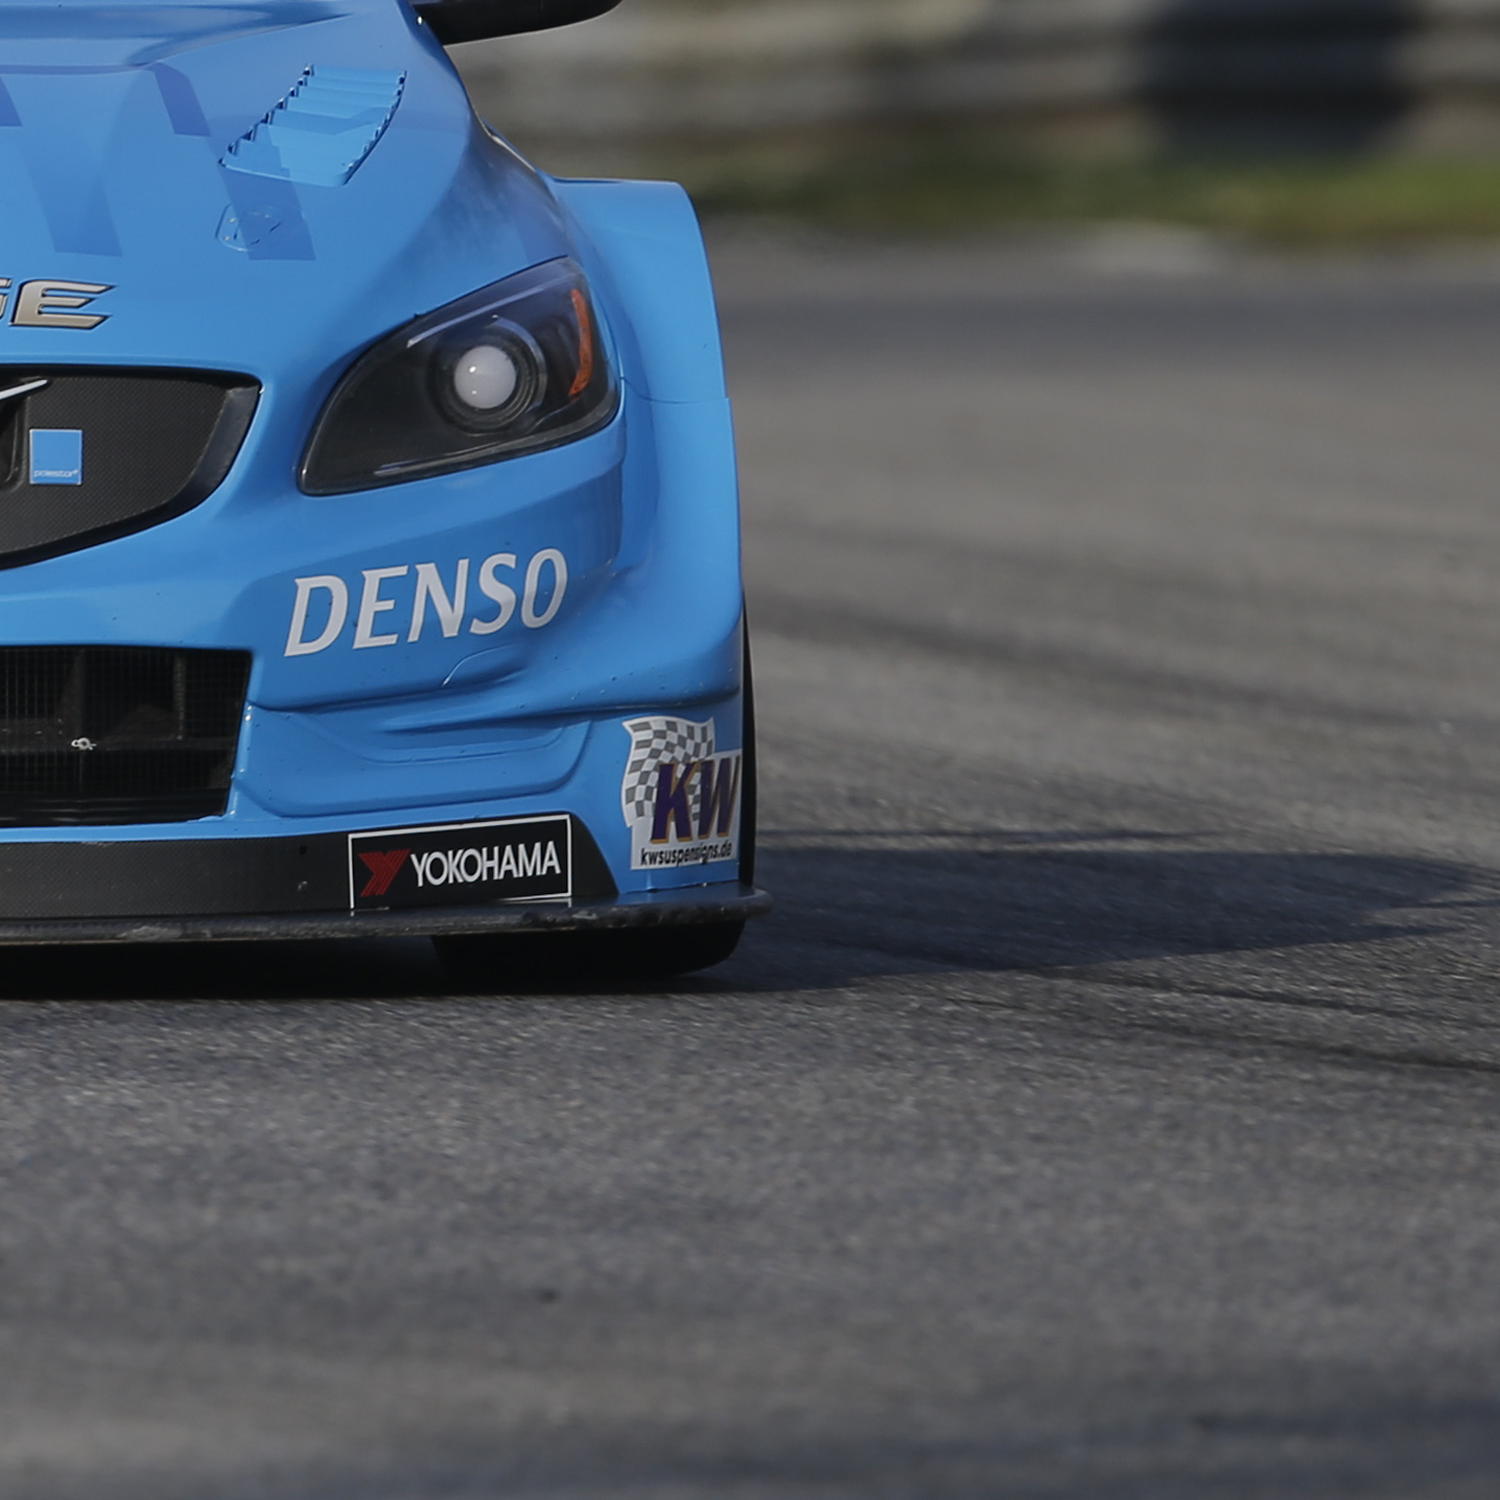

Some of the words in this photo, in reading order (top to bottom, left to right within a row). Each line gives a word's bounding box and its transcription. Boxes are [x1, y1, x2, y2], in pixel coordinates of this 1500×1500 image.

[284, 548, 568, 657] DENSO
[650, 755, 741, 845] KW
[411, 840, 561, 888] YOKOHAMA
